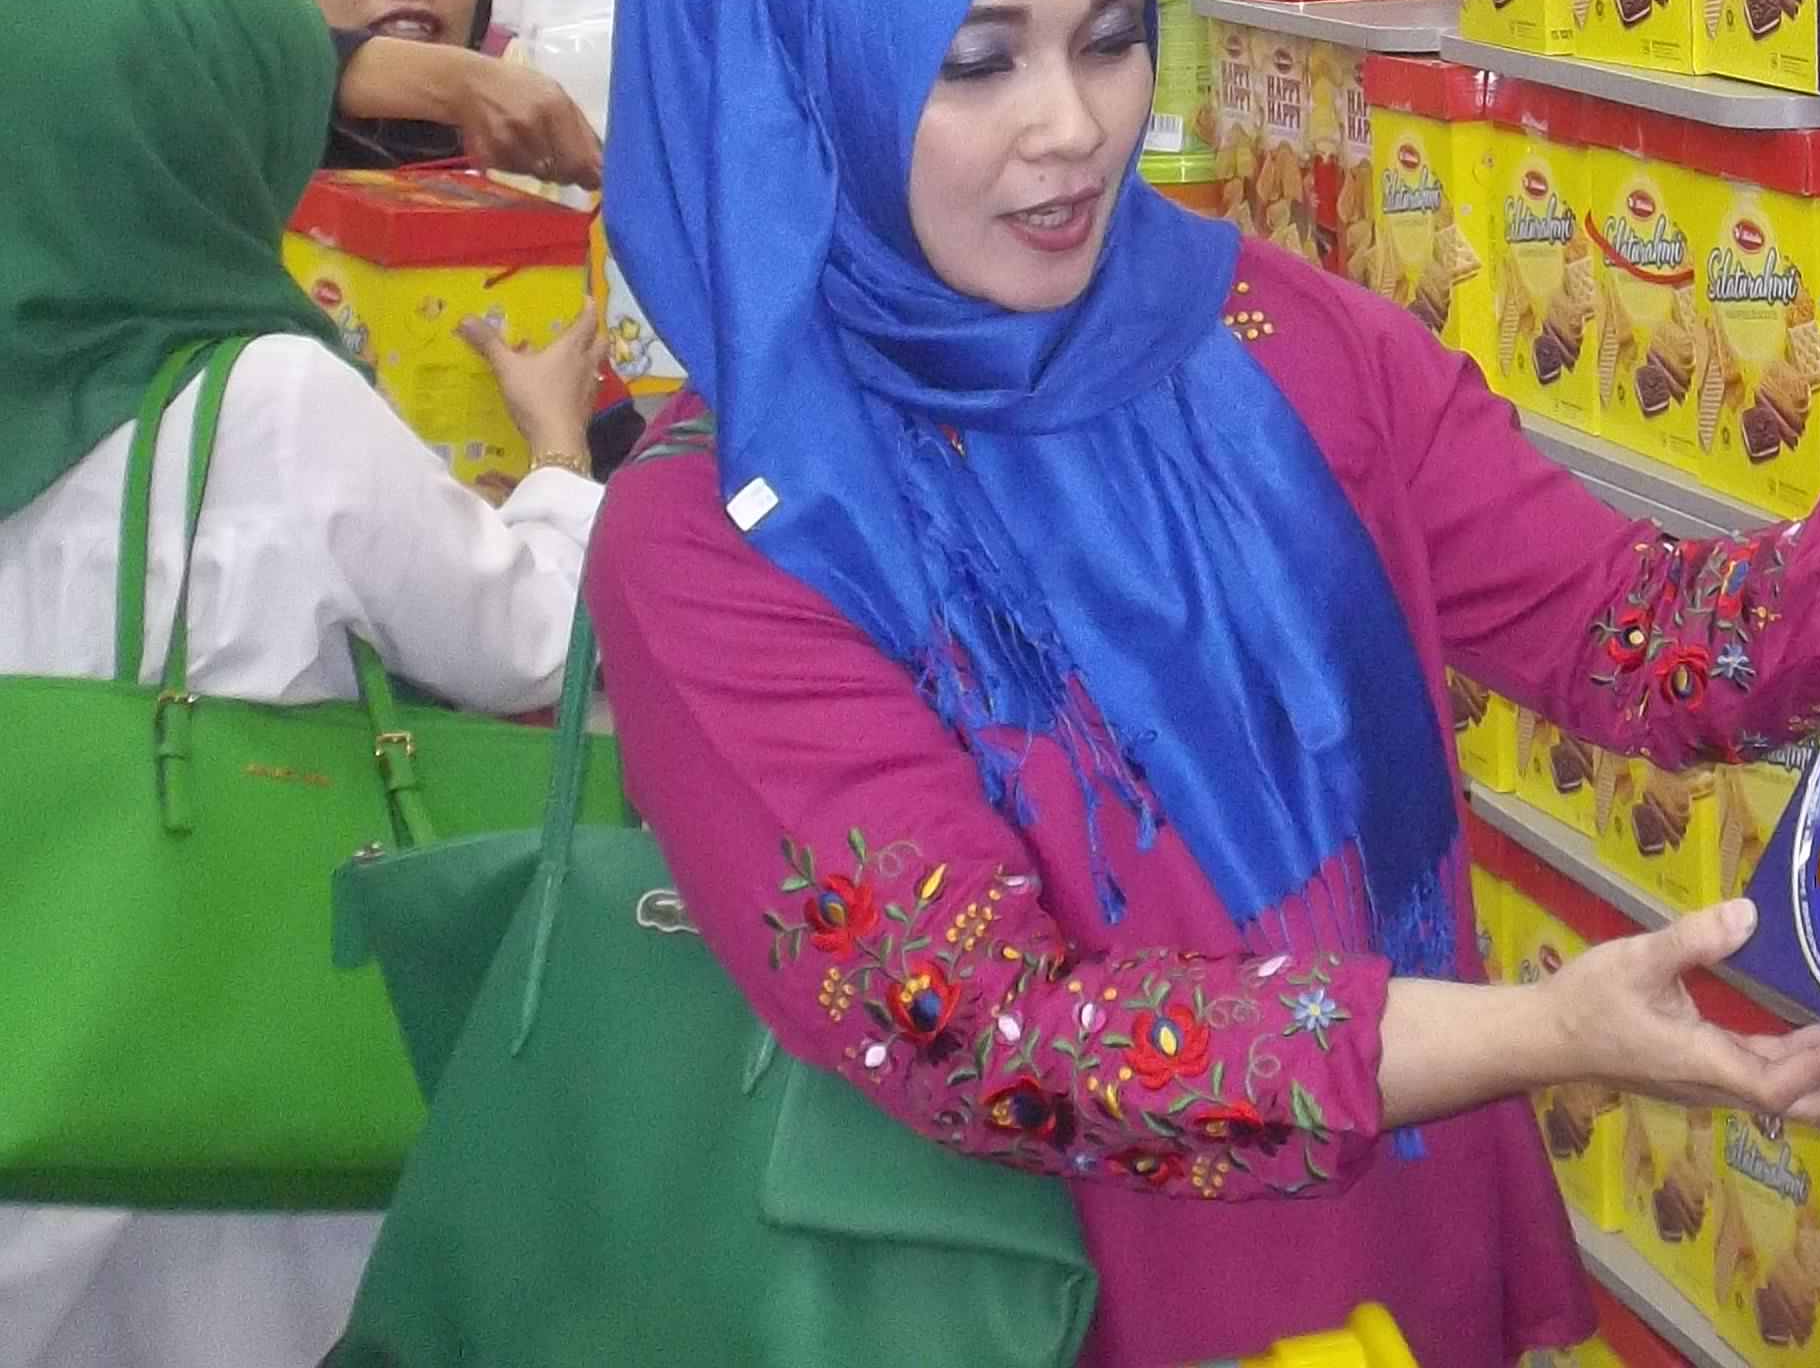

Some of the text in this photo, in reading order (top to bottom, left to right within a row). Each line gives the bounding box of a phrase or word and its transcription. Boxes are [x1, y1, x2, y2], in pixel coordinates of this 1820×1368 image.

[1267, 74, 1302, 99] HAPPY
[1267, 100, 1302, 129] HAPPY
[1504, 193, 1577, 244] Silaturahmi
[1706, 247, 1801, 308] Silaturahmi
